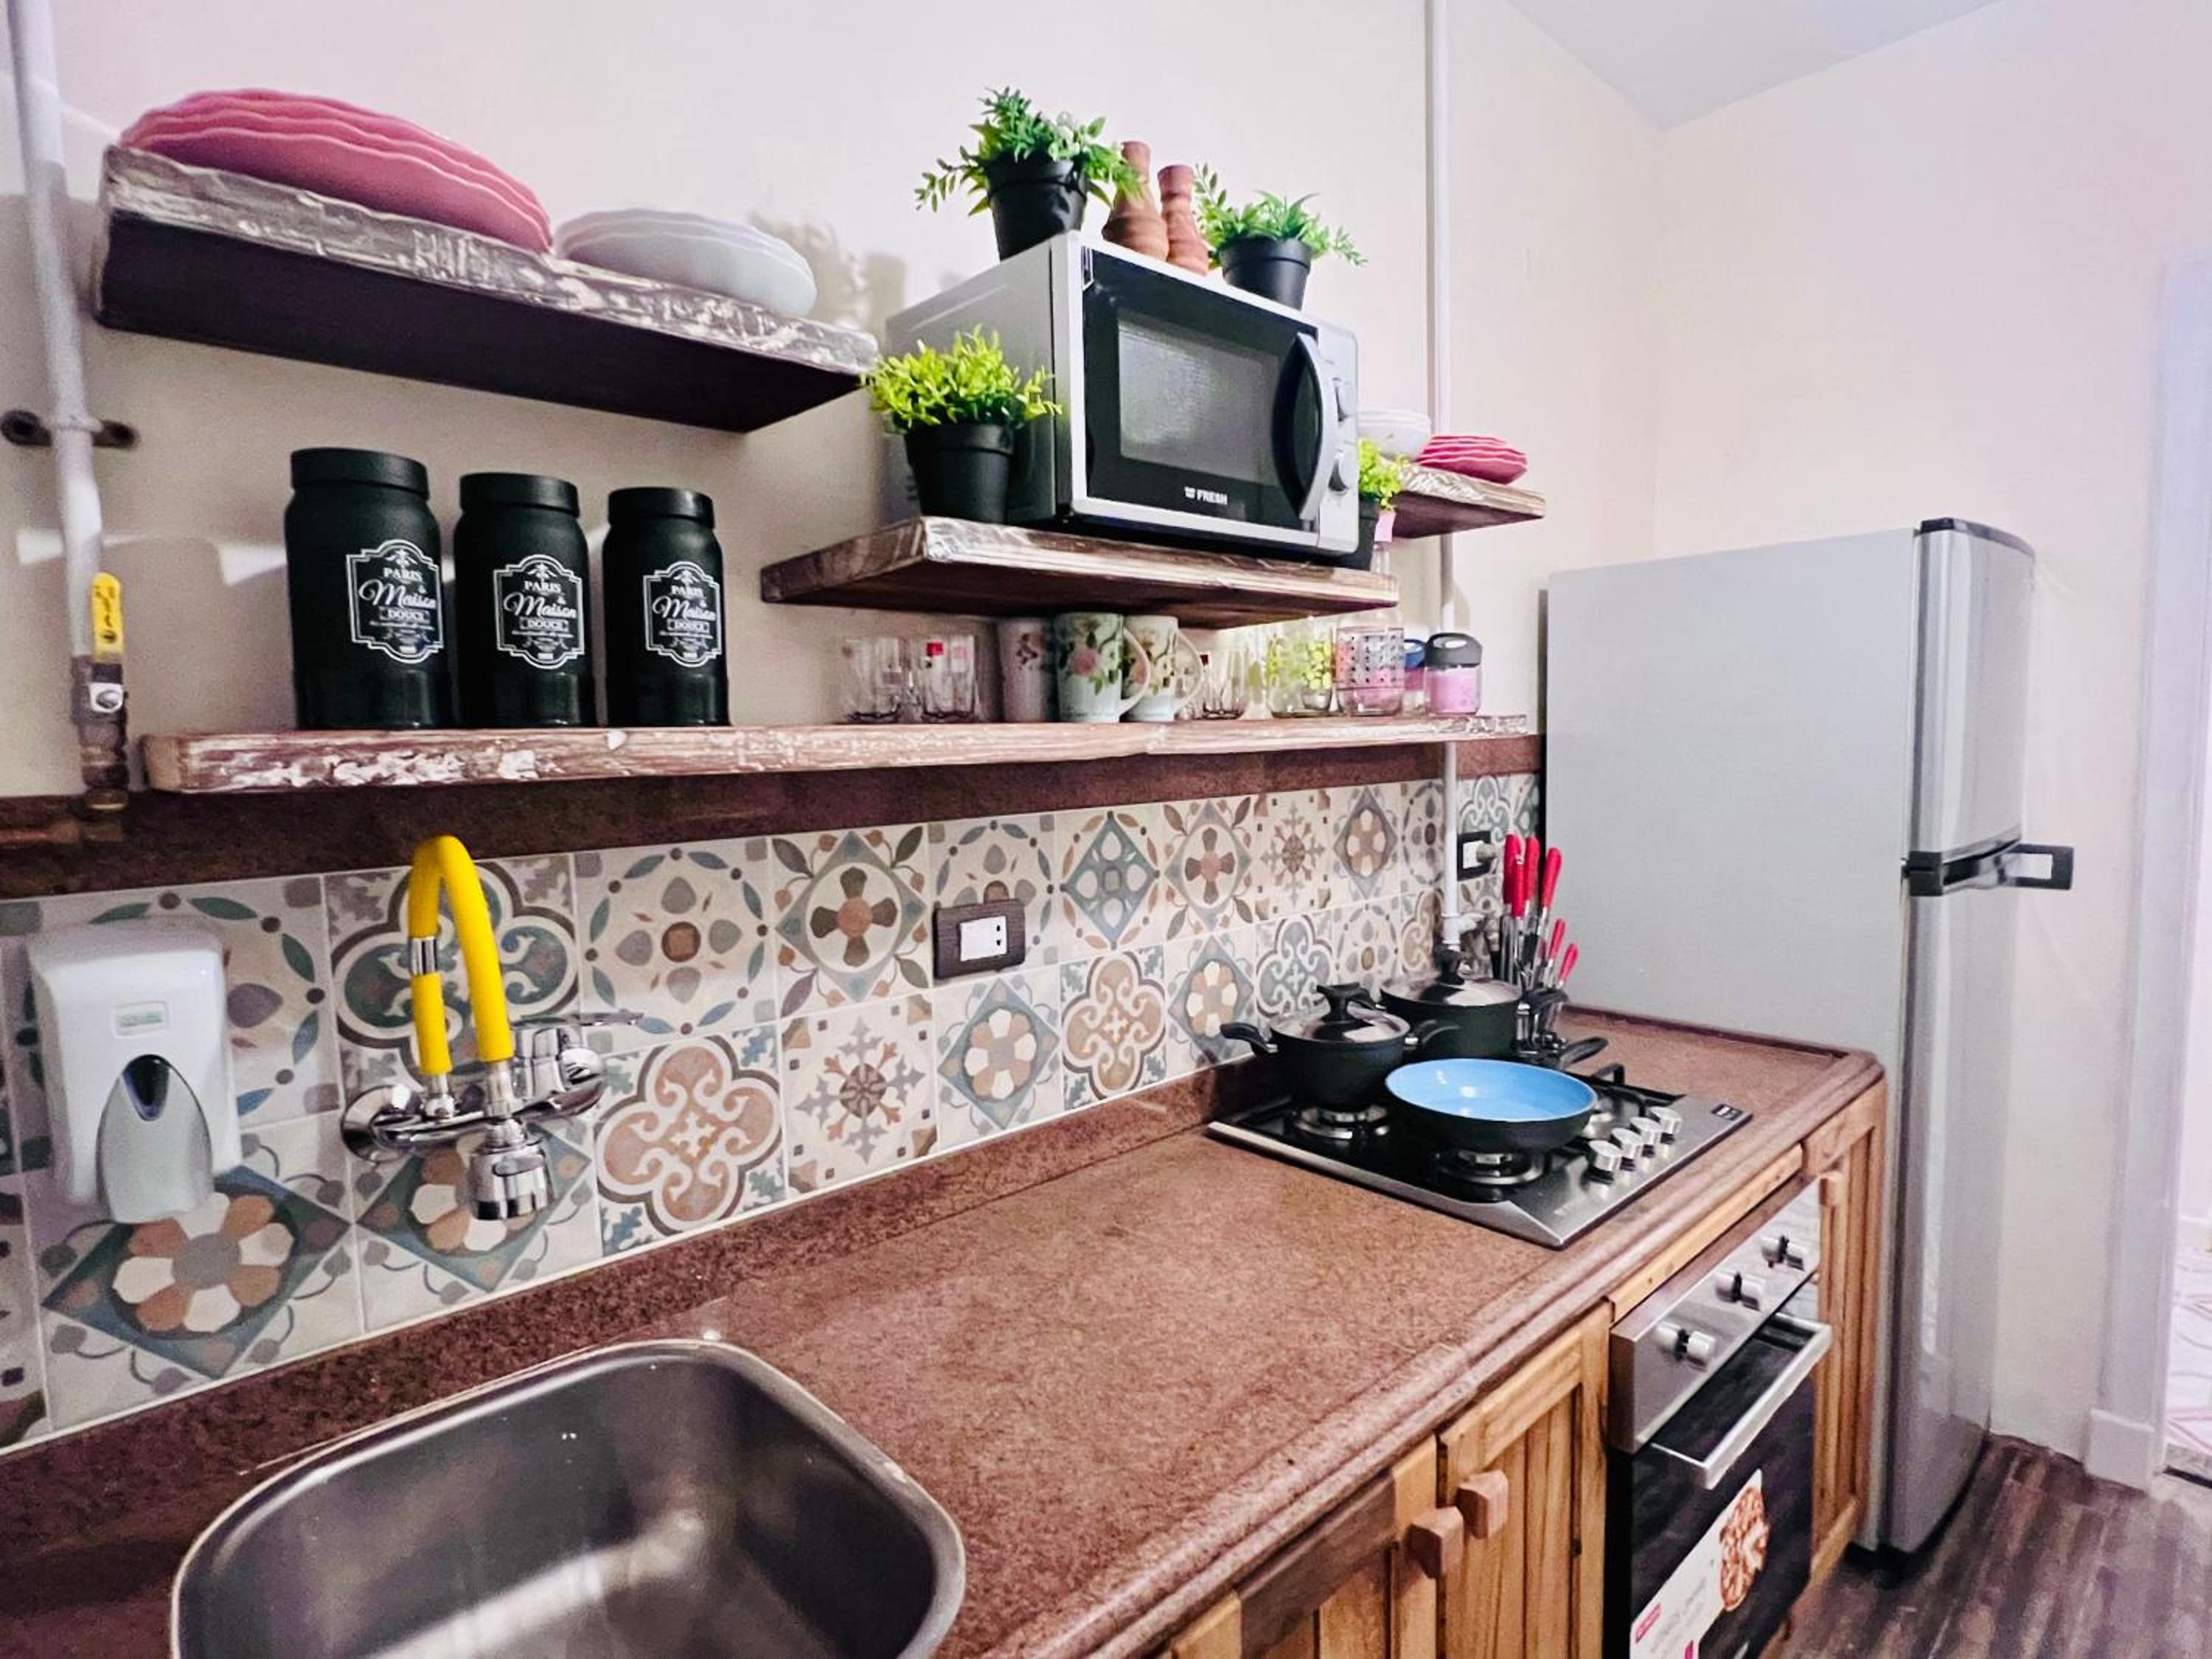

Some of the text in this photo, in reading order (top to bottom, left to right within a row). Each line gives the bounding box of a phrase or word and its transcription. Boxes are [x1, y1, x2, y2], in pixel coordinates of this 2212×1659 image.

[1197, 489, 1228, 505] FRESH
[383, 567, 422, 582] PARIS
[524, 581, 562, 593] PARIS
[504, 592, 577, 618] Maison
